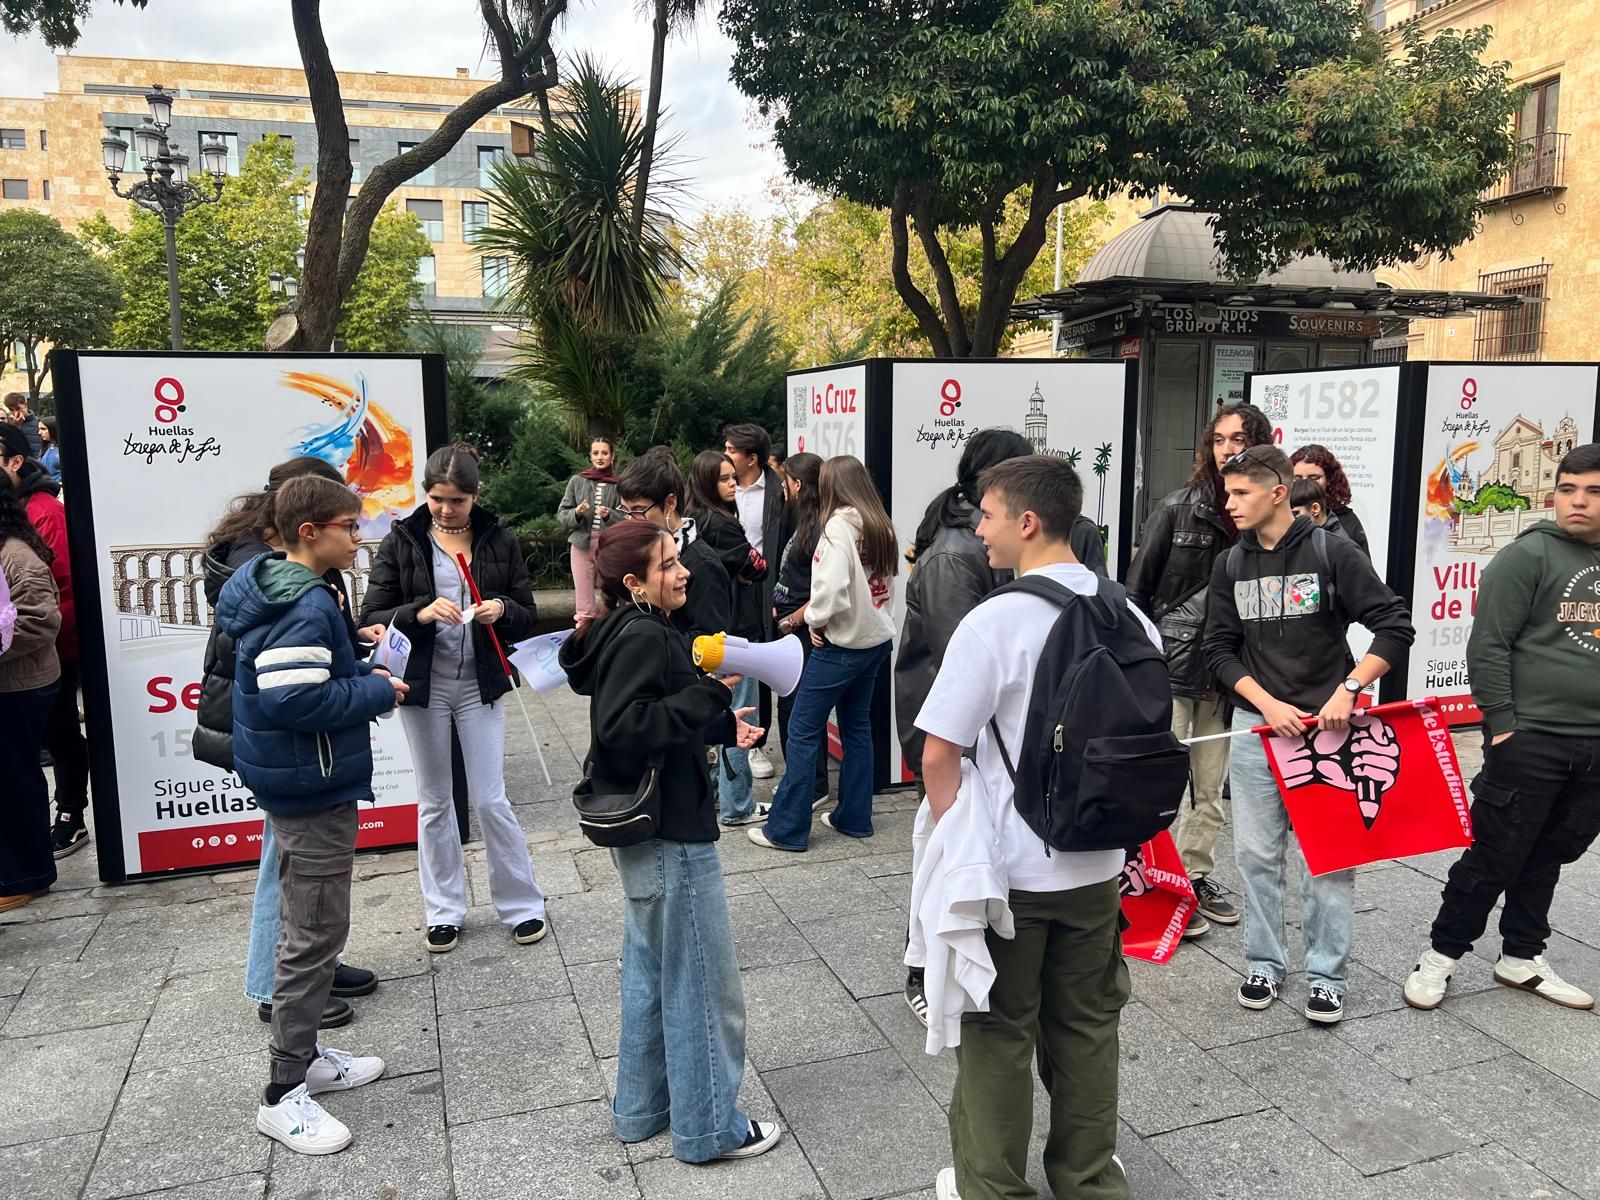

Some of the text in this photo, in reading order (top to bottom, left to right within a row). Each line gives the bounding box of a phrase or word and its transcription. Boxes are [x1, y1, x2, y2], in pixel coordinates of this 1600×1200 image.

[1165, 308, 1259, 322] LOS NDOS
[1288, 315, 1364, 332] SOUVENIRS
[1061, 321, 1096, 338] LOS BANDOS
[1165, 320, 1252, 333] GRUPO R.H.
[811, 383, 857, 415] la Cruz
[1228, 391, 1243, 399] AGU
[1298, 379, 1380, 420] 1582
[148, 425, 194, 436] Huellas
[934, 418, 965, 428] Huellas
[811, 420, 857, 458] 1576
[1433, 561, 1484, 591] Vill
[1431, 590, 1478, 621] de l
[1427, 659, 1466, 673] Sigue s
[1425, 671, 1470, 689] Huella
[146, 676, 203, 714] Se
[150, 729, 193, 758] 15
[154, 776, 244, 798] Sigue su
[1427, 728, 1473, 839] Estudiantes
[155, 793, 258, 820] Huellas
[246, 820, 384, 843] ww .com
